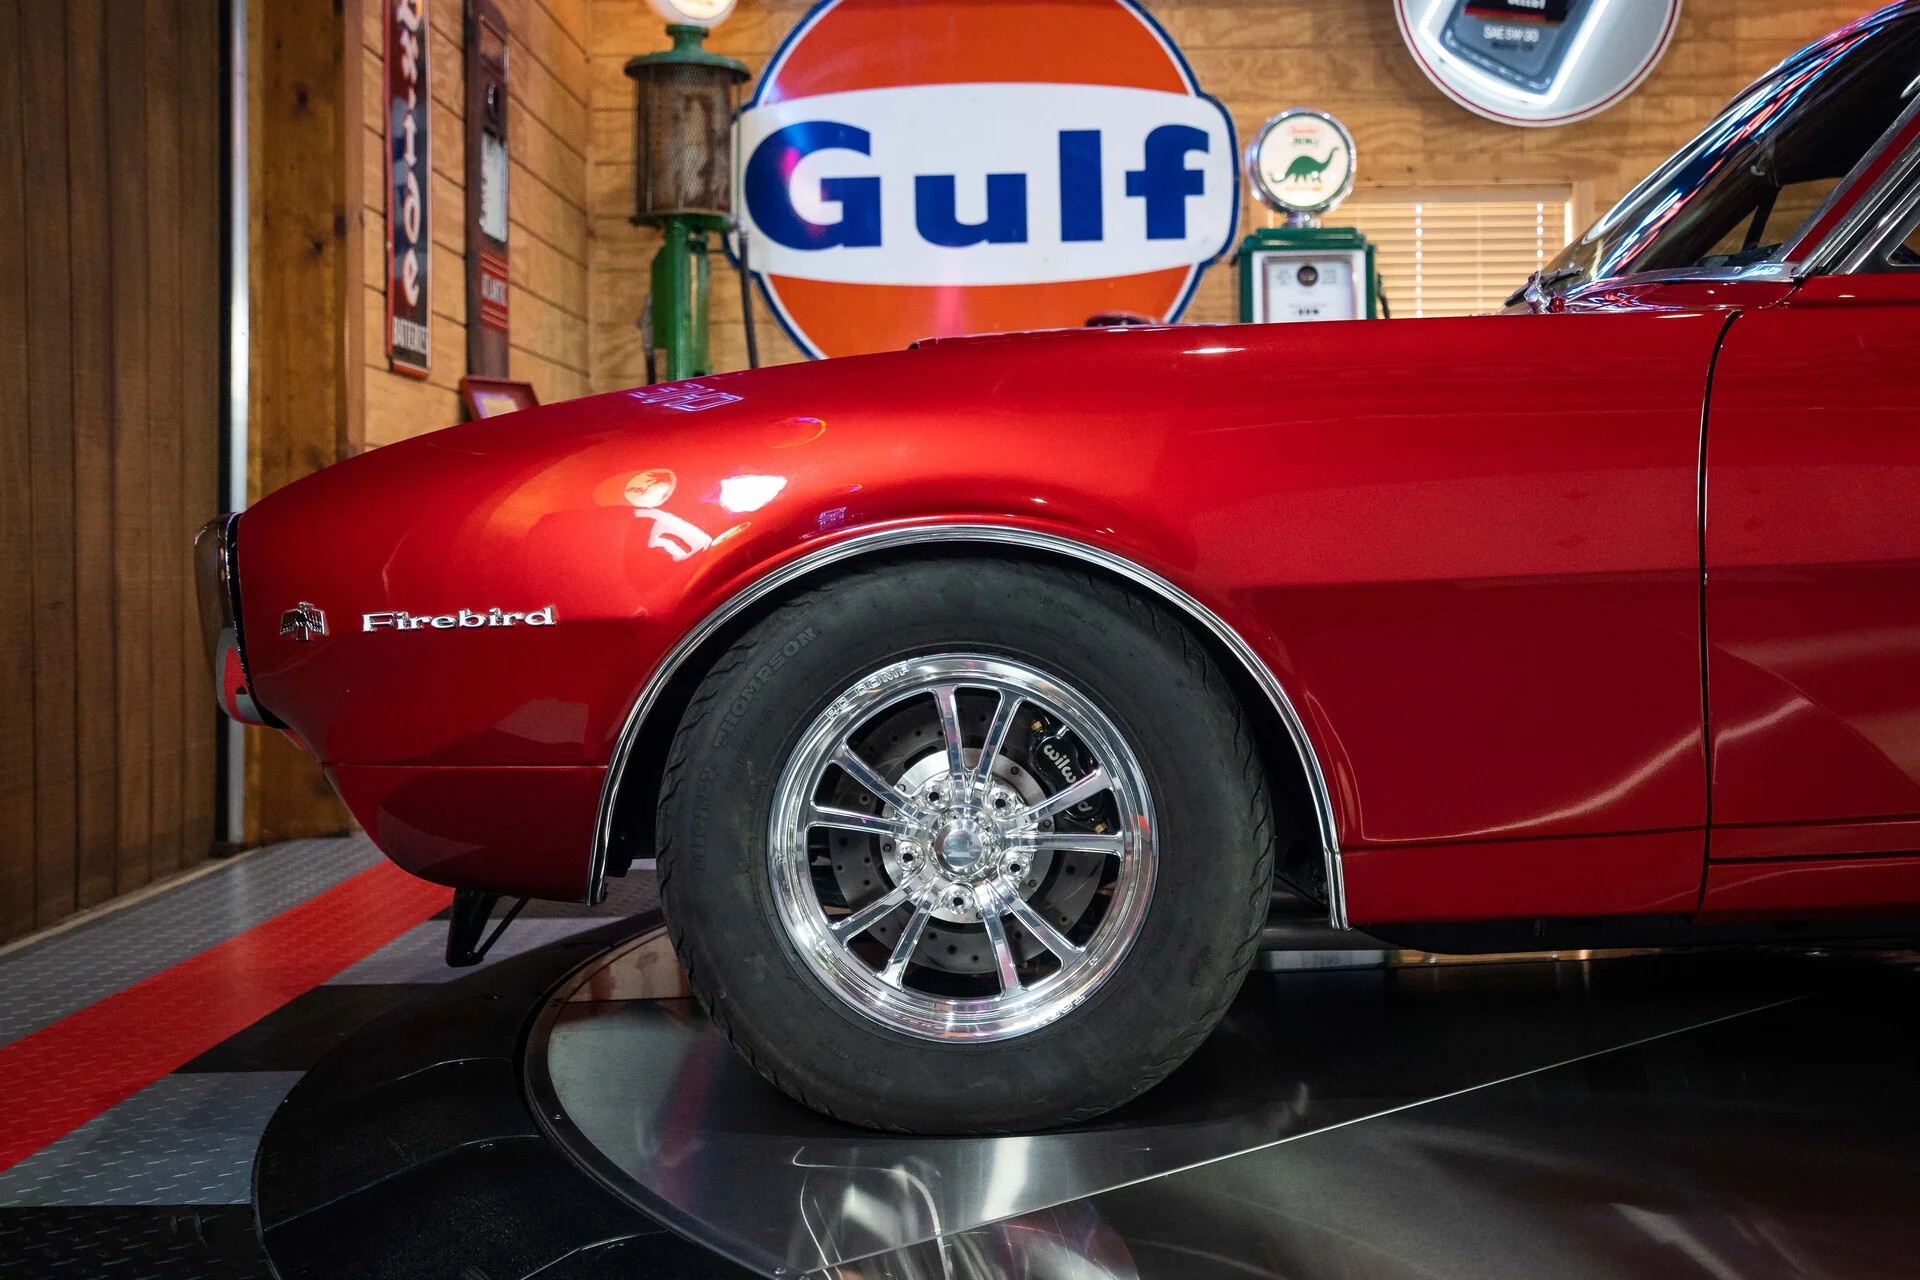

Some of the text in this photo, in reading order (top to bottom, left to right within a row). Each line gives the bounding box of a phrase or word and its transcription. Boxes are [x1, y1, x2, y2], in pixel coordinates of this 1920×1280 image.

[744, 120, 1209, 250] Gulf
[362, 605, 557, 632] Firebird
[713, 627, 817, 748] THOMPSON
[826, 664, 909, 720] RC COMP
